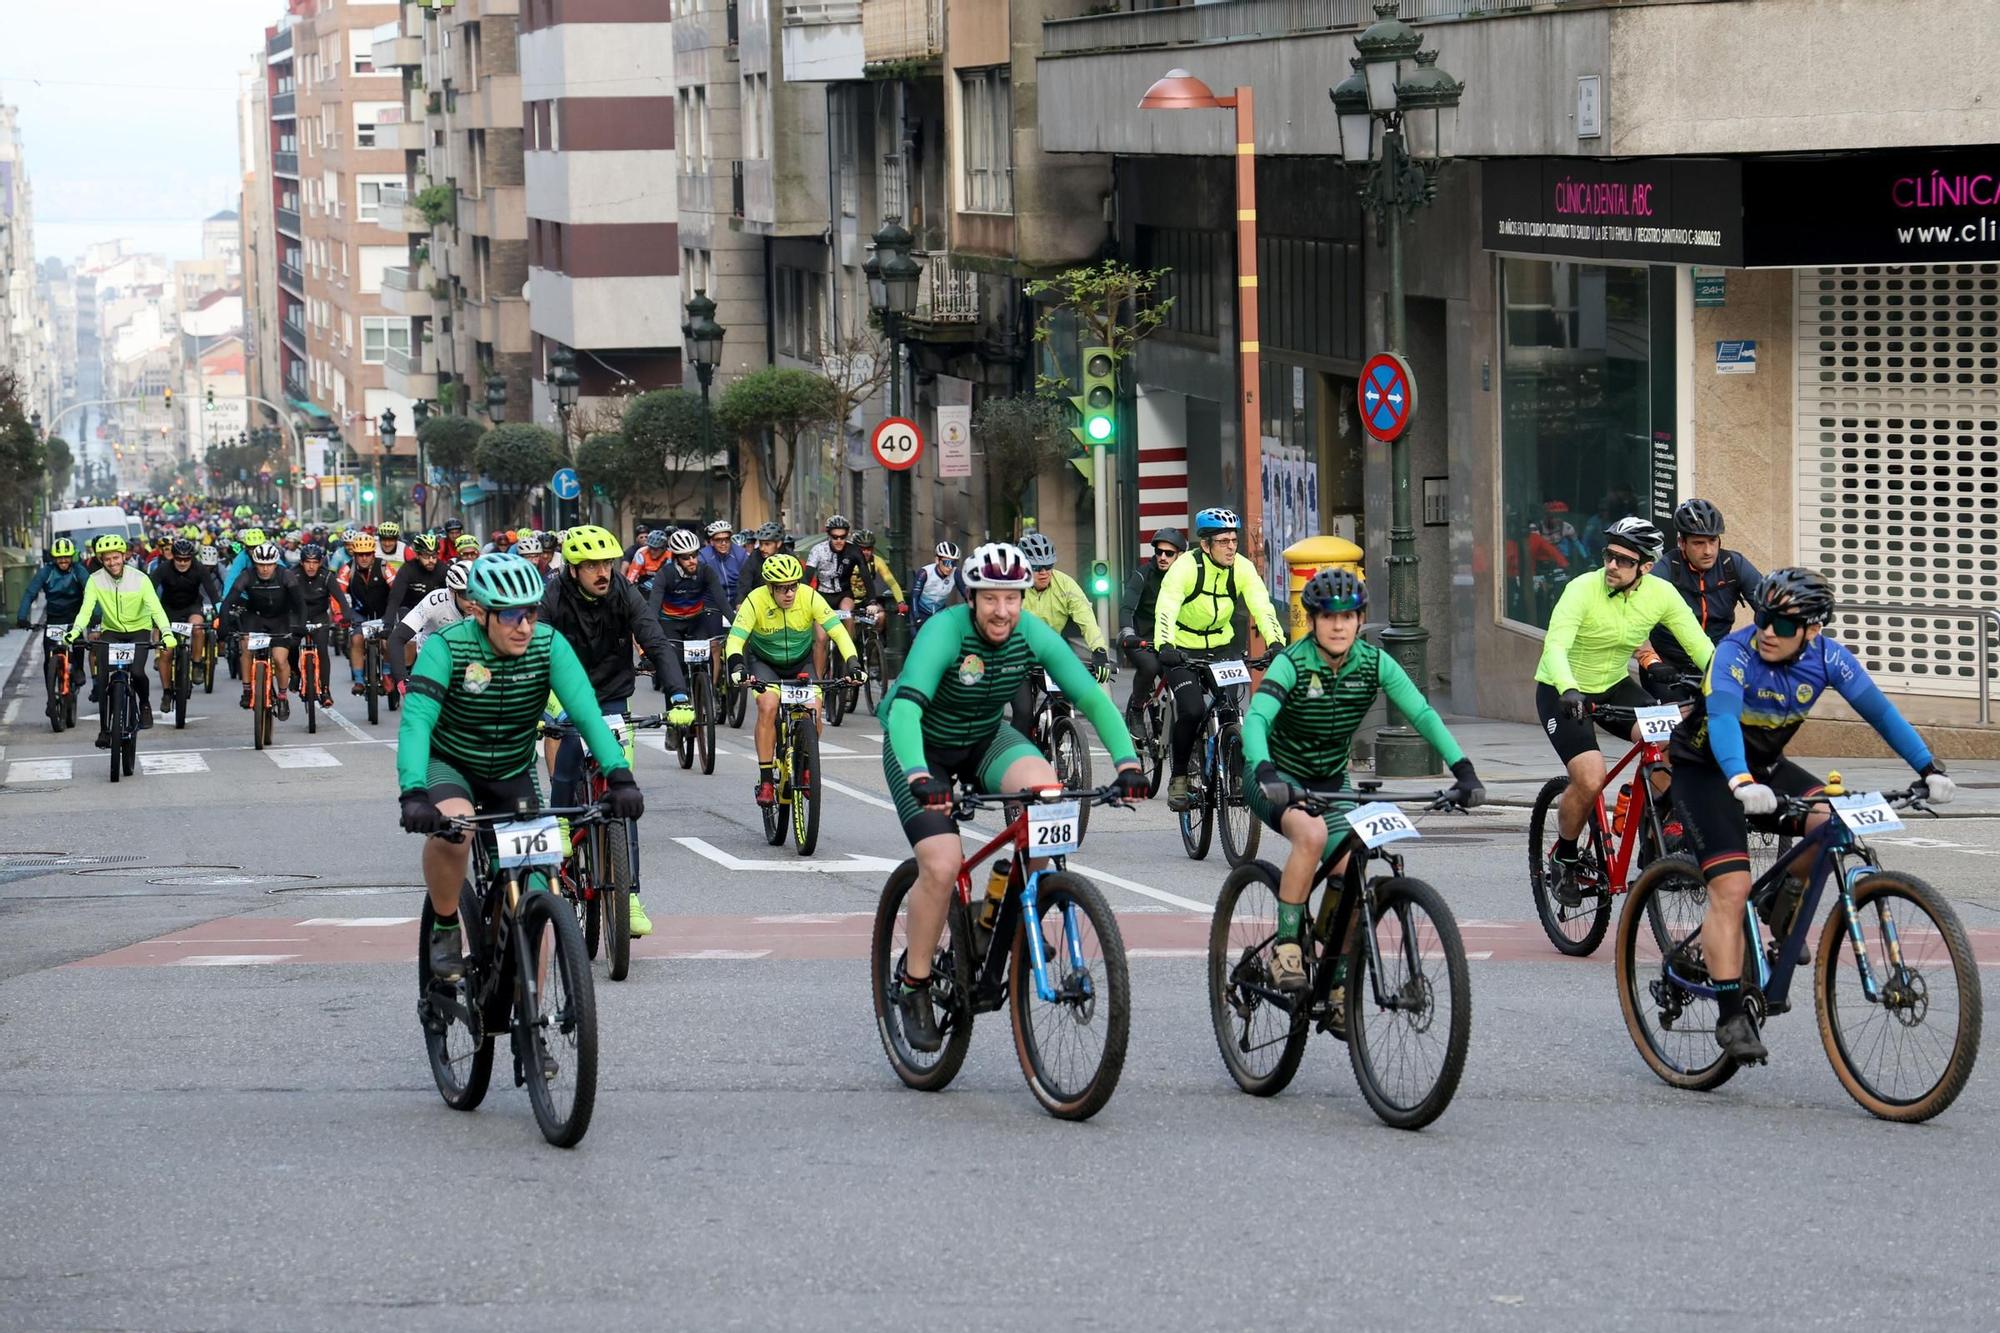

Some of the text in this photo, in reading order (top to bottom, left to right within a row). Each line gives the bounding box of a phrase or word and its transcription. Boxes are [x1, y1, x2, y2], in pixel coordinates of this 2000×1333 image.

[1555, 176, 1653, 216] CLÍNICA DENTAL ABC
[1518, 222, 1524, 235] EN
[1524, 222, 1530, 236] TU
[1531, 222, 1546, 237] CIUDAD
[1547, 223, 1570, 238] CUIDANDO
[1570, 224, 1577, 238] TU
[1577, 225, 1591, 240] SALUD
[1591, 226, 1595, 240] Y
[1595, 226, 1601, 240] LA
[1602, 226, 1608, 240] DE
[1609, 226, 1615, 240] TU
[1616, 226, 1632, 241] FAMILIA
[1661, 228, 1688, 244] SANITARIO
[1897, 217, 2000, 243] www.cli
[881, 435, 912, 452] 40
[1219, 668, 1245, 680] 362
[787, 689, 809, 699] 397
[1645, 719, 1677, 734] 326
[1366, 816, 1407, 836] 285
[1851, 808, 1889, 825] 152
[510, 833, 548, 854] 176
[1037, 824, 1072, 845] 288
